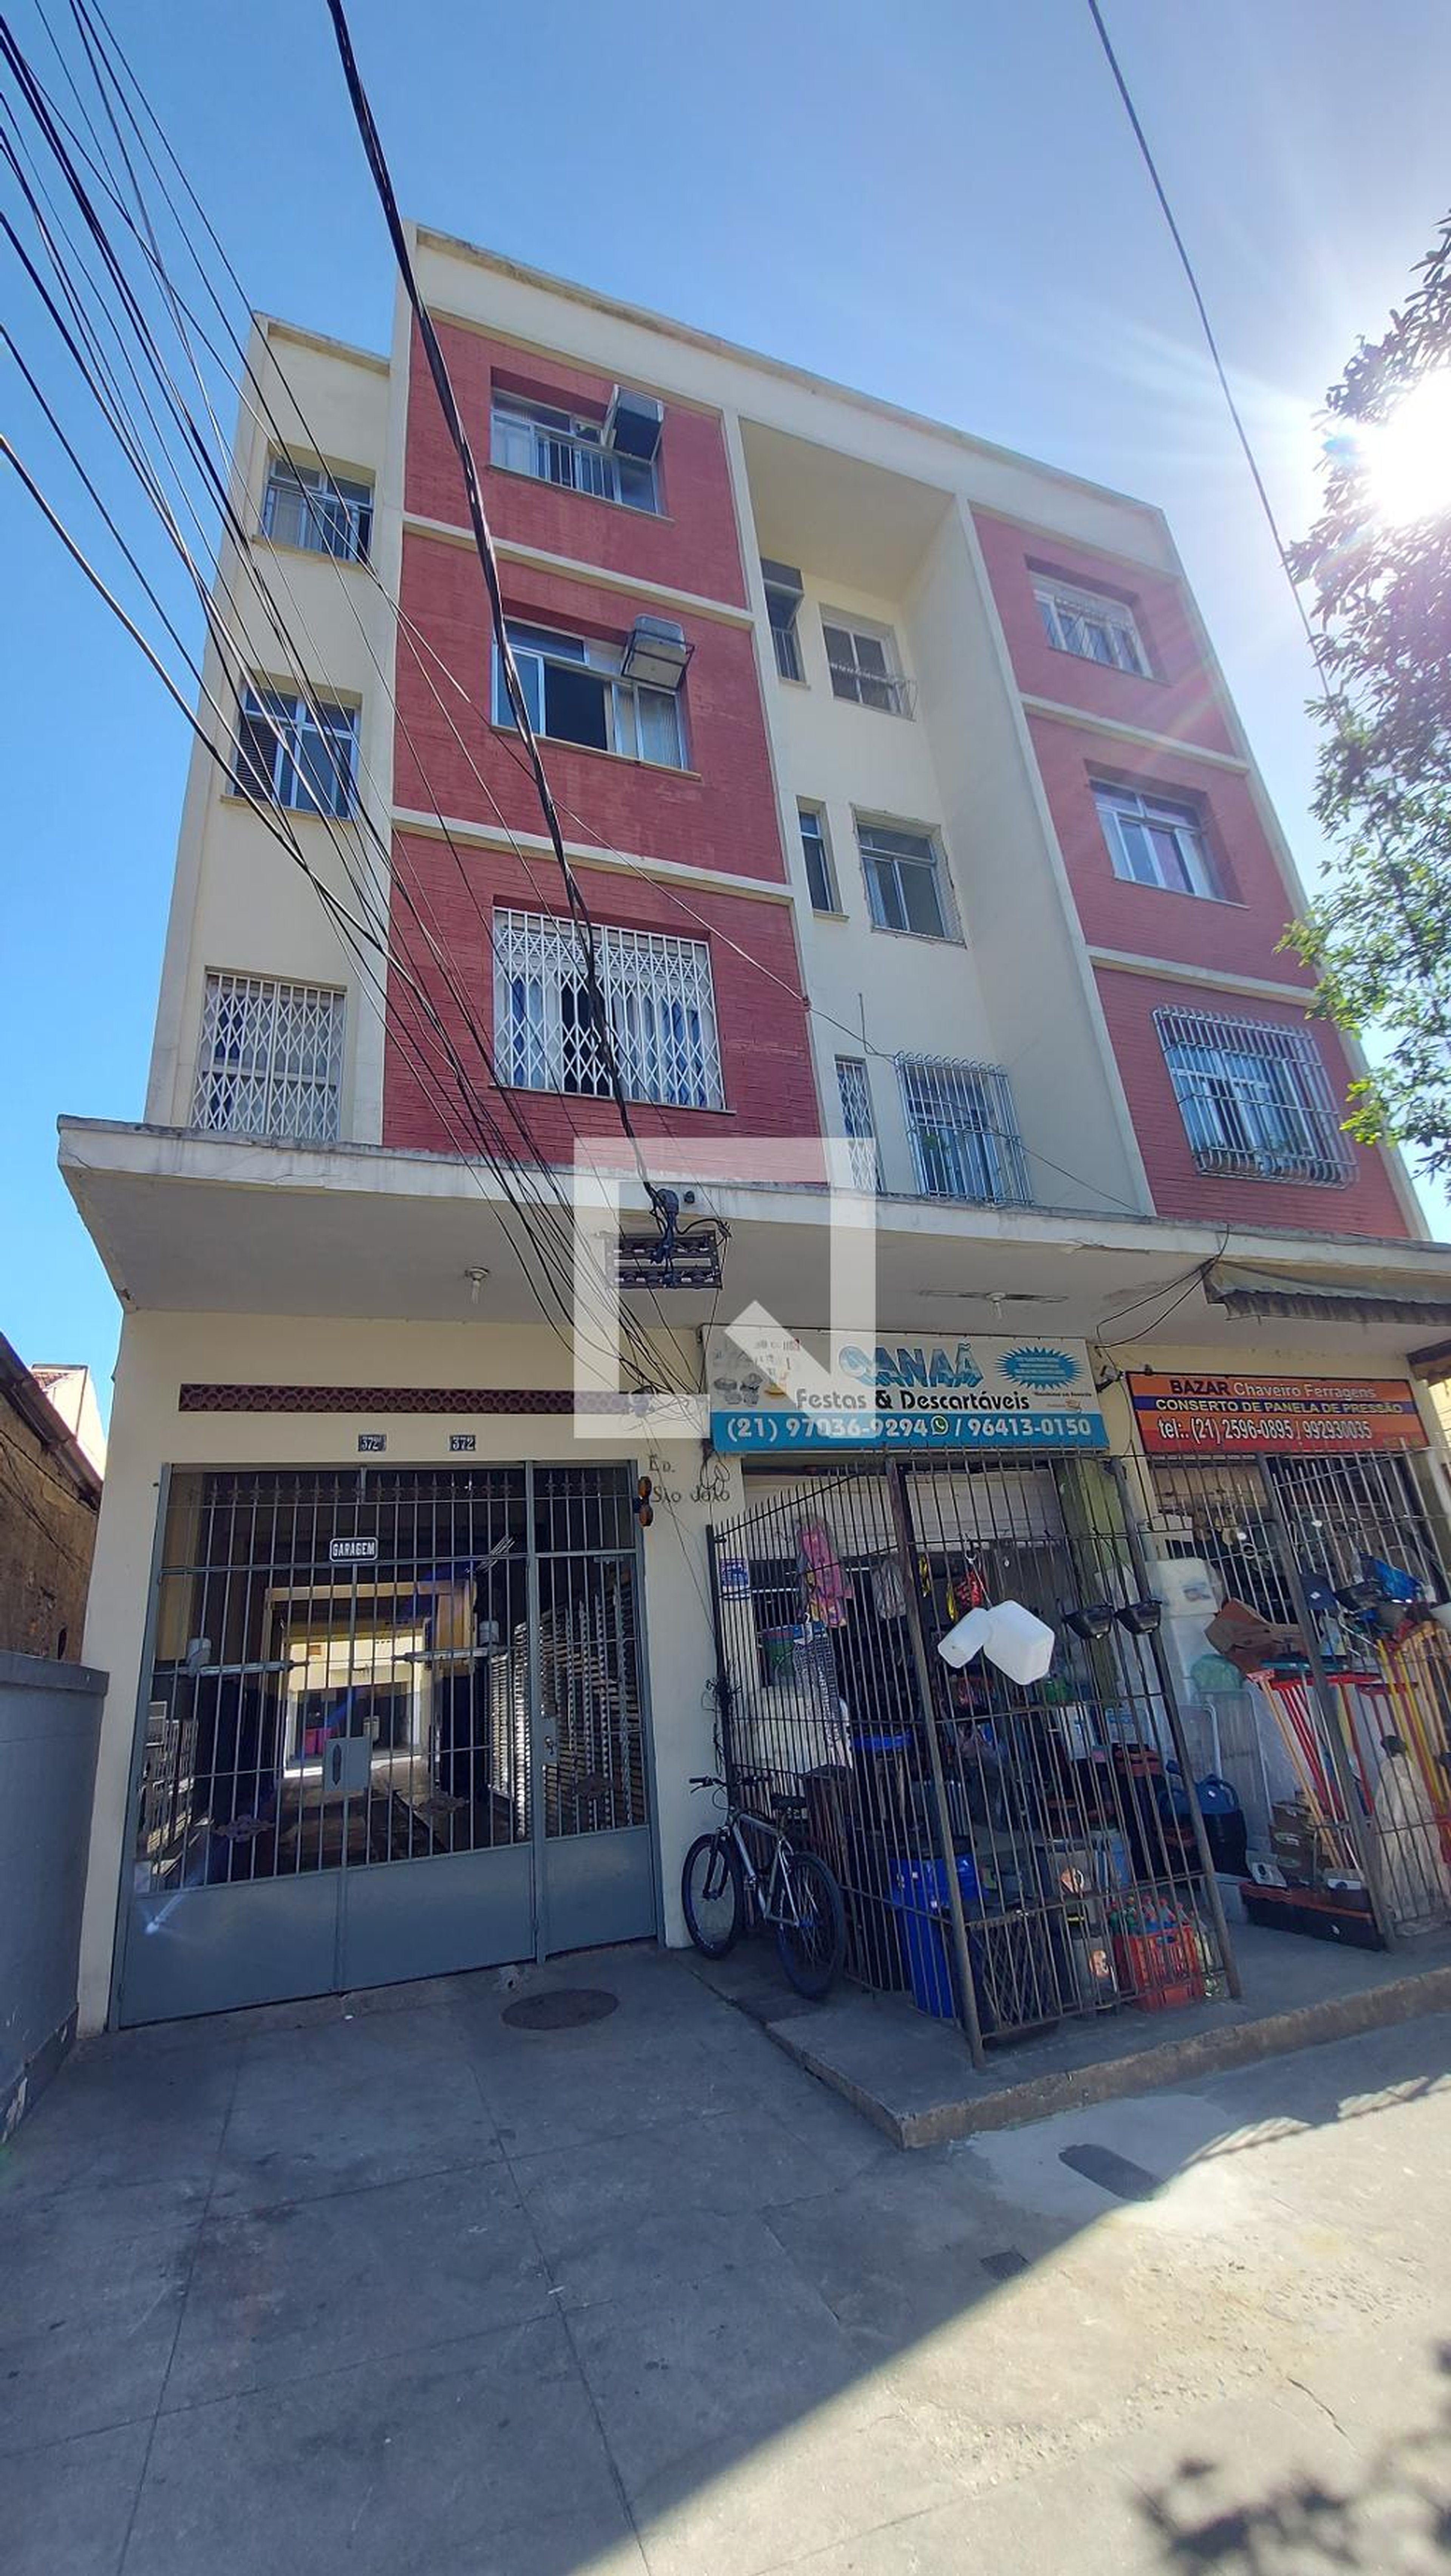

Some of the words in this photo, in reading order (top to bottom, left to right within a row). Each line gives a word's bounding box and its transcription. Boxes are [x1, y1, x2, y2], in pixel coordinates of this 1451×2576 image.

[796, 1389, 866, 1409] Festas
[876, 1390, 893, 1409] &
[900, 1390, 1030, 1409] Descartáveis
[1170, 1380, 1230, 1395] BAZAR
[1234, 1382, 1301, 1396] Chaveiro
[1304, 1384, 1377, 1401] Ferragens
[1156, 1399, 1238, 1411] CONSERTO
[1242, 1402, 1261, 1412] DE
[1264, 1402, 1319, 1413] PANELA
[1322, 1403, 1341, 1413] DE
[1343, 1402, 1403, 1414] PRESSÃO
[728, 1418, 777, 1442] (21)
[955, 1419, 961, 1436] /
[967, 1418, 1091, 1436] 96413-0150
[1191, 1418, 1221, 1444] (21)
[1222, 1419, 1294, 1439] 2596-0895
[453, 1437, 474, 1450] 372
[333, 1542, 374, 1556] GARAGEM
